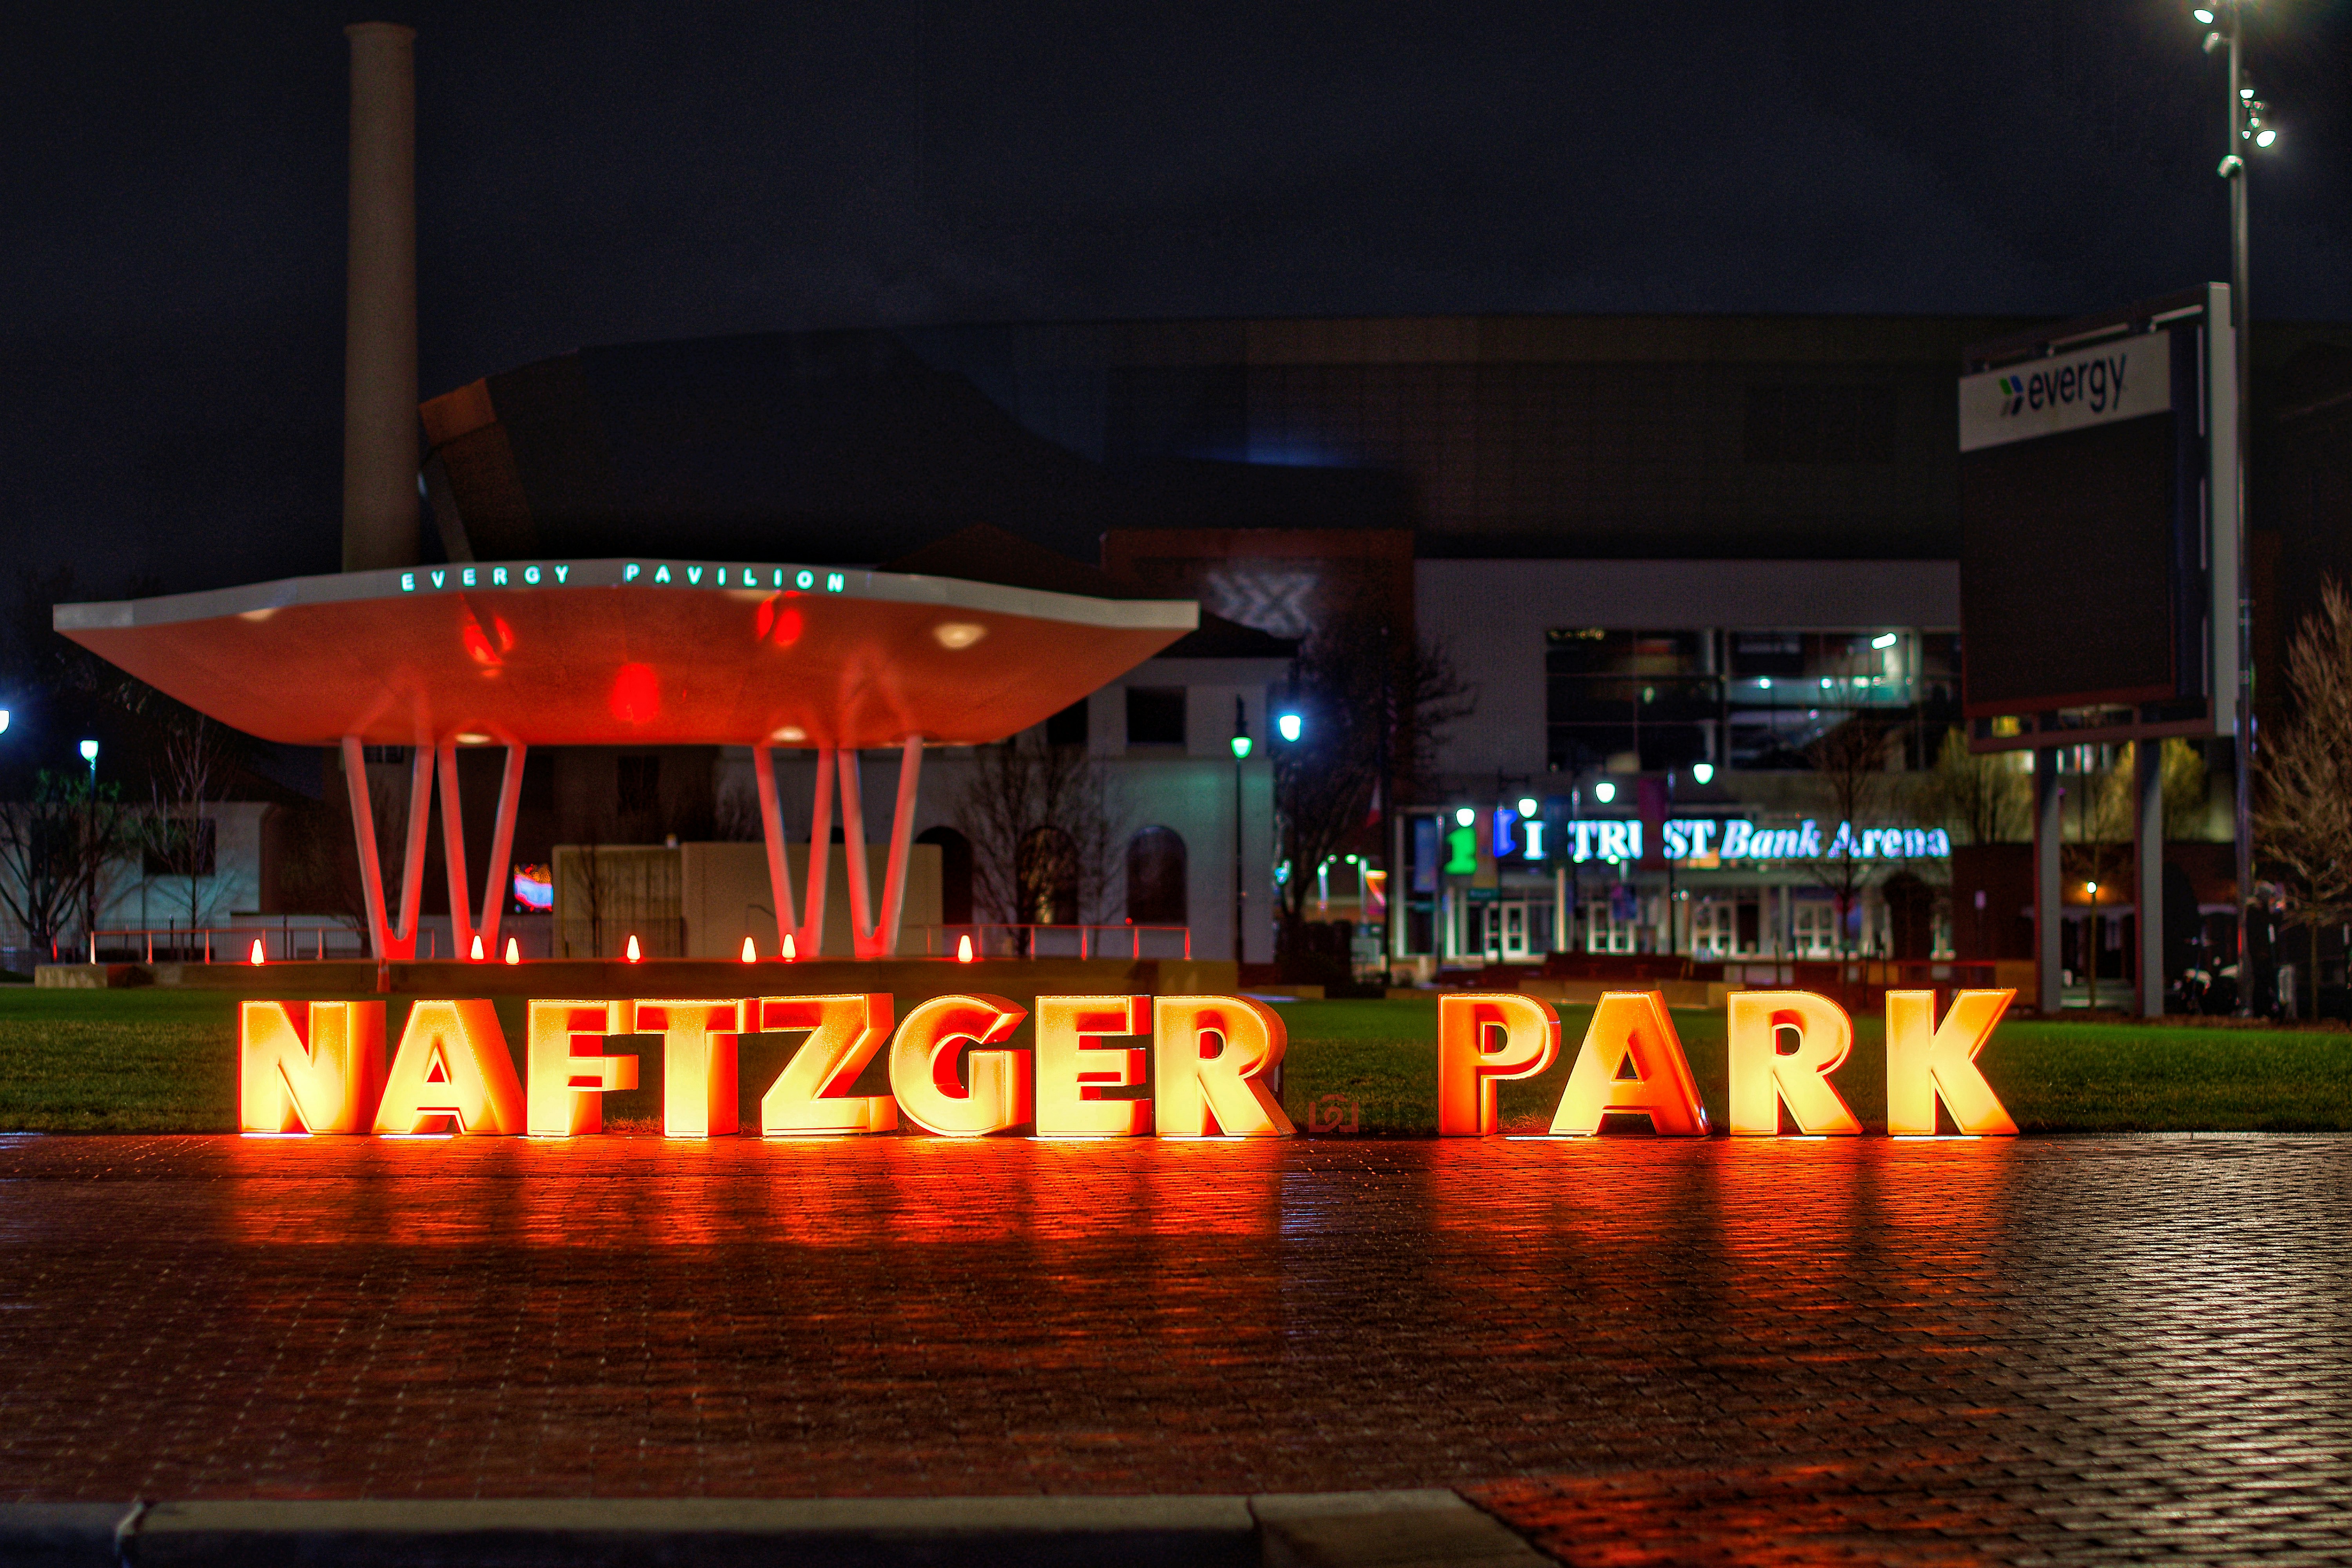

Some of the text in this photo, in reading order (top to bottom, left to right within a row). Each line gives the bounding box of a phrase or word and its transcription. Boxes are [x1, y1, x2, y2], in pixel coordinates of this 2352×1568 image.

[2029, 353, 2127, 413] evergy
[400, 562, 845, 593] EVERGY PAVILION
[1522, 818, 1951, 859] ITRST Bank Arena
[238, 988, 2020, 1138] NAFTZGER PARK
